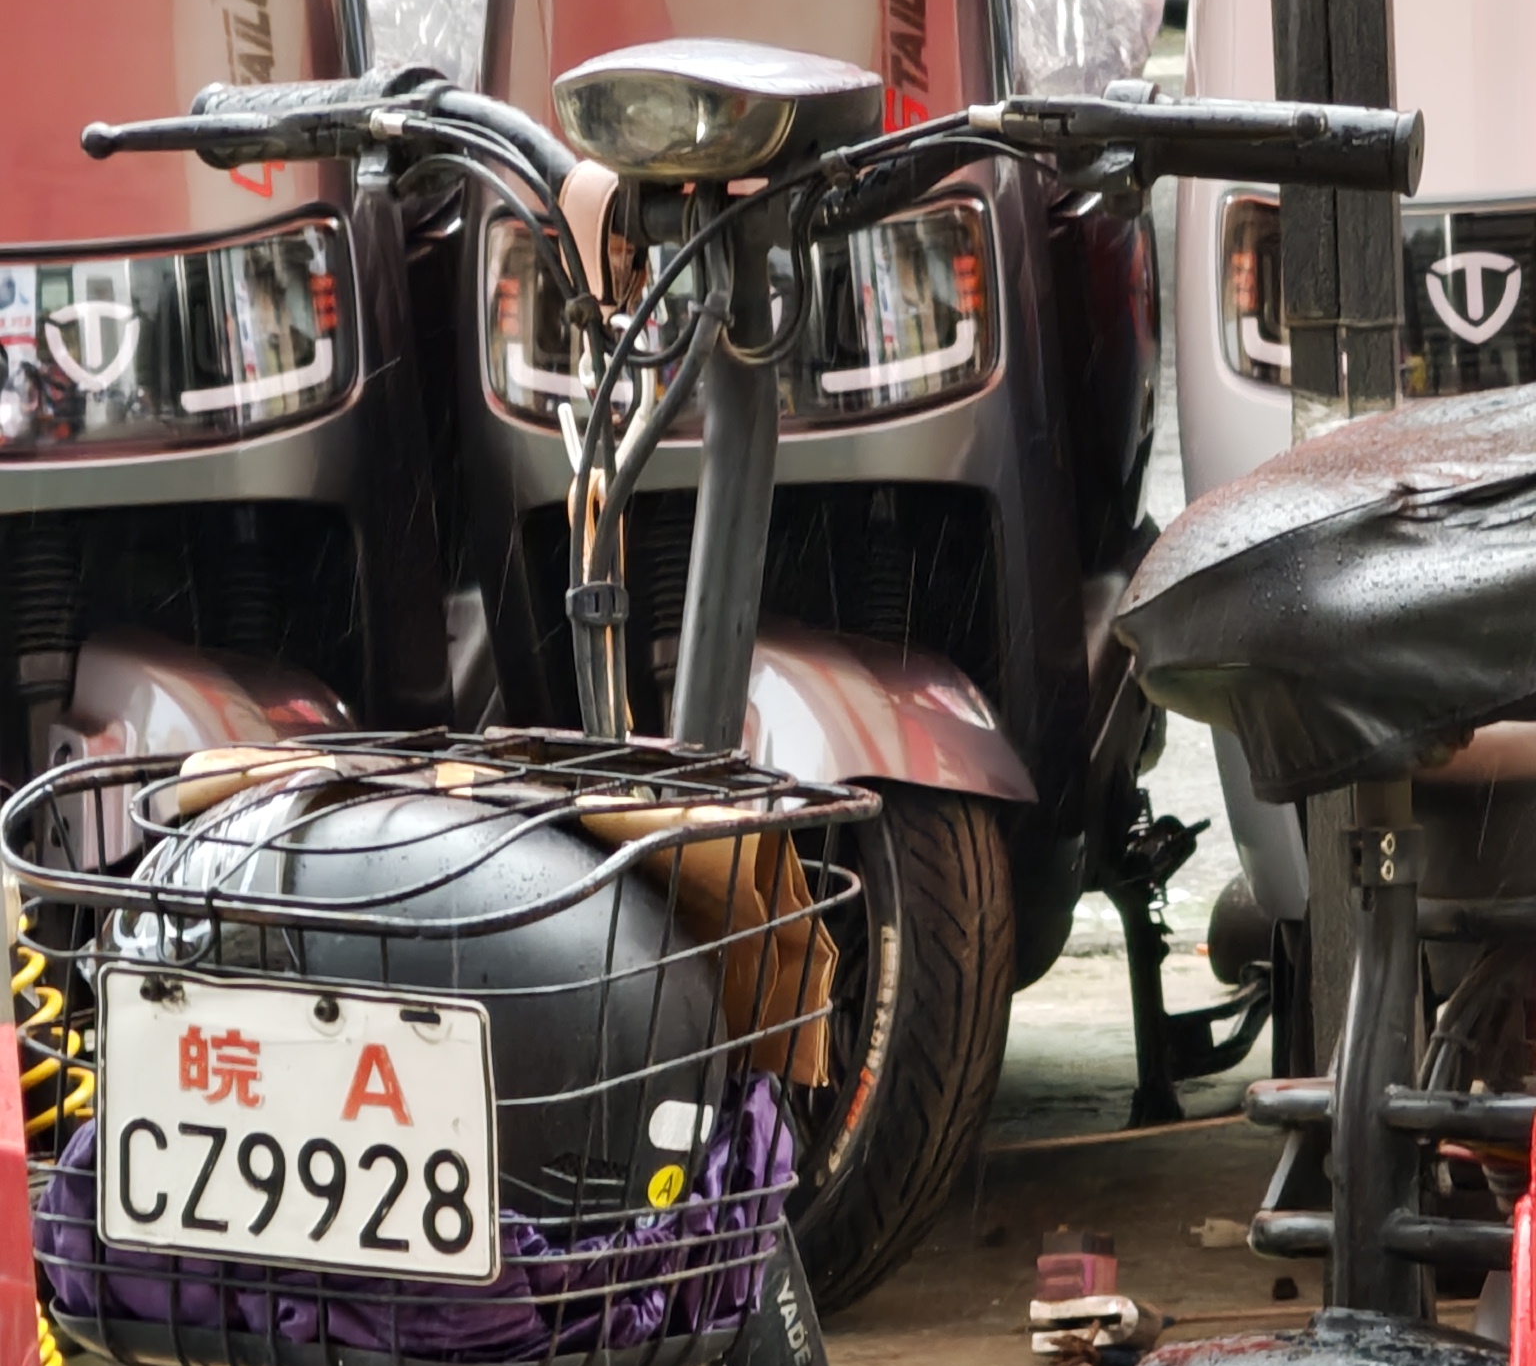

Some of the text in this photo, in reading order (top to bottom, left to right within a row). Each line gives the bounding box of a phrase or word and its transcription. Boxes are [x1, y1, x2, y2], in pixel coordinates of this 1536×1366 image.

[178, 1024, 415, 1127] 皖 A
[119, 1116, 475, 1255] CZ9928
